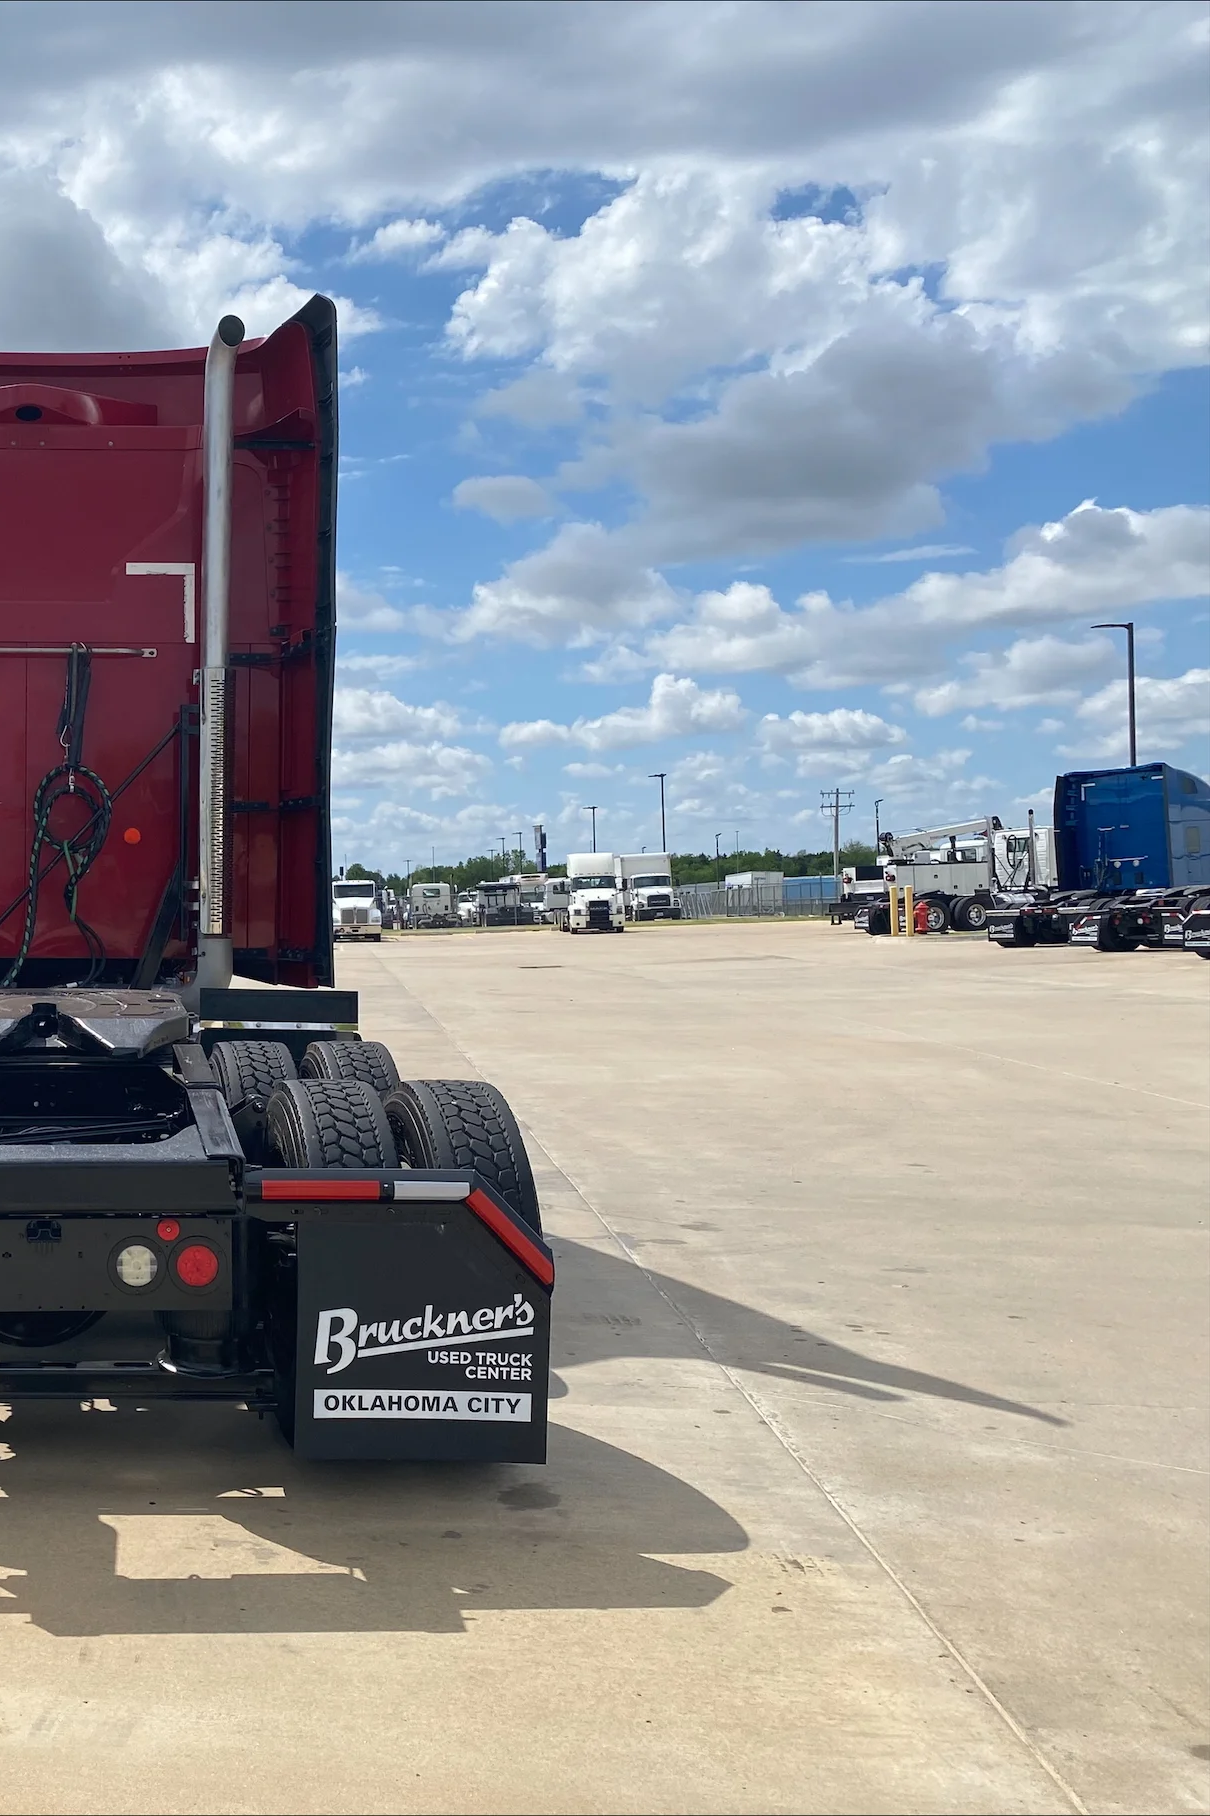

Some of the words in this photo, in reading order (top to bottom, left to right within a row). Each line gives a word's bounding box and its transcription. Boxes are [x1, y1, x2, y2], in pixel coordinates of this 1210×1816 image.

[314, 1293, 535, 1375] Bruckner's
[427, 1351, 472, 1365] USED
[475, 1352, 533, 1367] TRUCK
[465, 1366, 533, 1381] CENTER
[323, 1394, 459, 1413] OKLAHOMA
[467, 1397, 522, 1414] CITY
